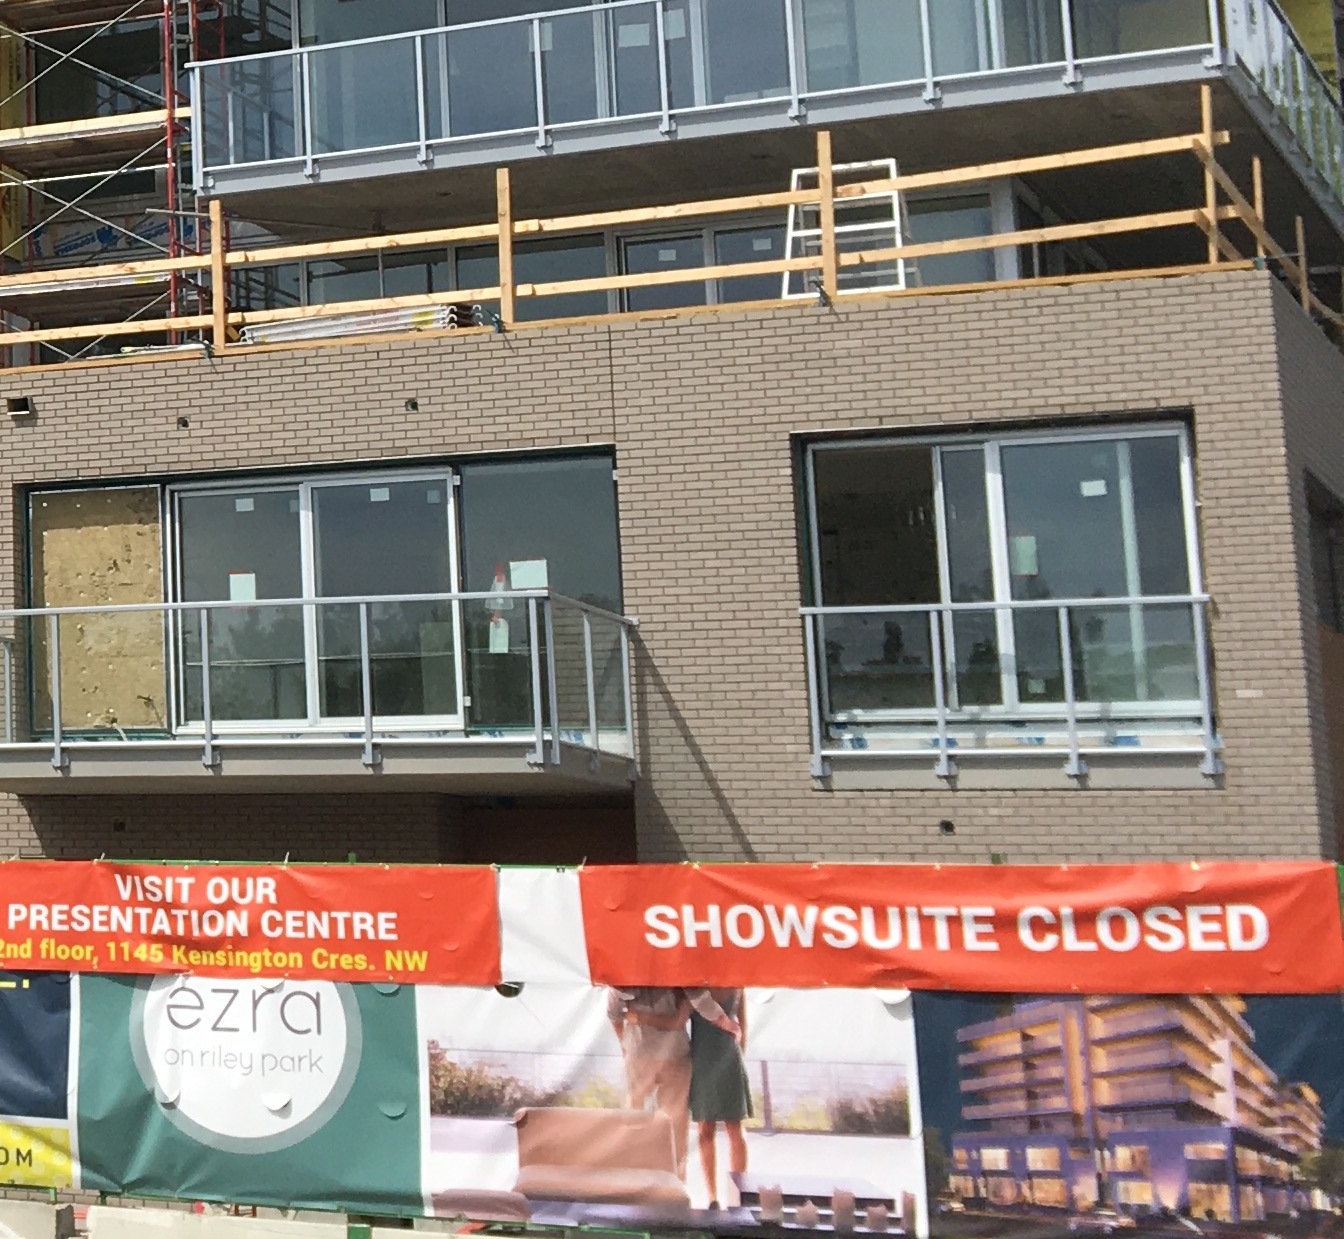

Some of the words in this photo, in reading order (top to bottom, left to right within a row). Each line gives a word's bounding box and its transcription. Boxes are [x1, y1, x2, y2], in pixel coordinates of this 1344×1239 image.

[115, 873, 195, 903] VISIT
[206, 877, 277, 904] OUR
[8, 904, 248, 938] PRESENTATION
[261, 909, 398, 940] CENTRE
[644, 903, 1002, 952] SHOWSUITE
[1017, 904, 1272, 953] CLOSED
[39, 938, 98, 964] floor,
[107, 941, 164, 964] 1145
[172, 944, 303, 974] Kensington
[311, 949, 376, 971] Cres.
[385, 951, 428, 972] NW
[166, 986, 321, 1035] ezra
[165, 1048, 194, 1067] on
[200, 1045, 254, 1076] riley
[261, 1049, 324, 1077] park
